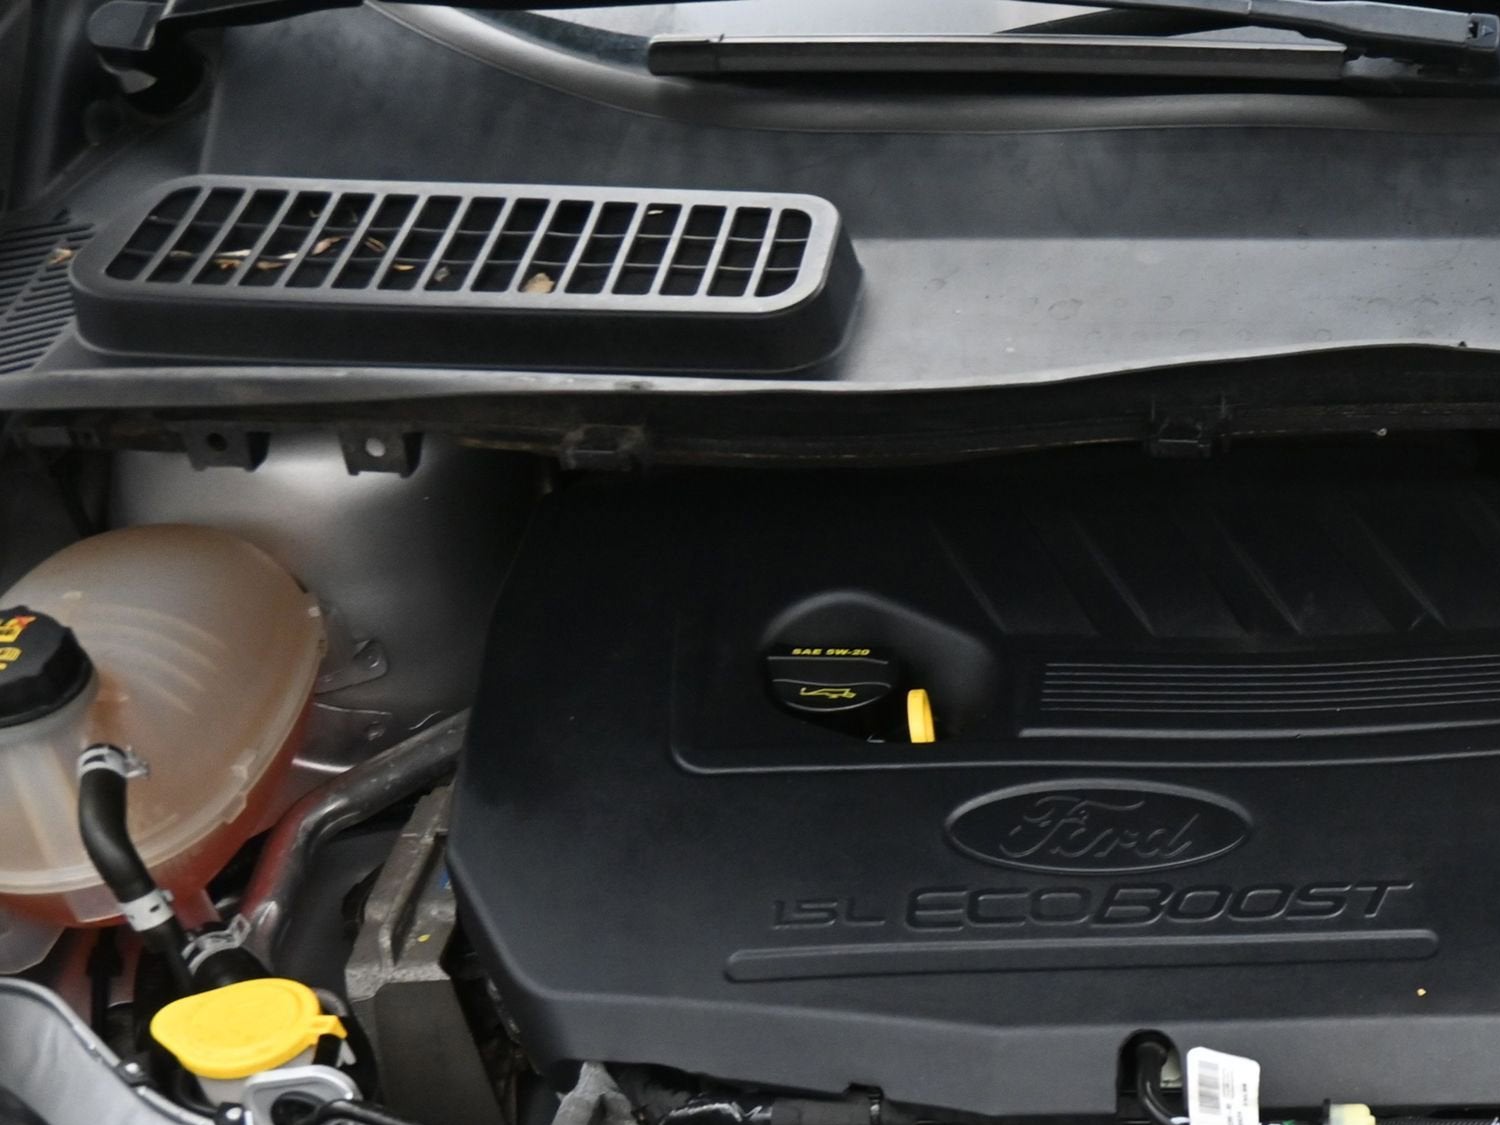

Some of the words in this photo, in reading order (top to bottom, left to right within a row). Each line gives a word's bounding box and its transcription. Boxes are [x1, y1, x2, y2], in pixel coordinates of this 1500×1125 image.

[791, 647, 822, 656] SAE
[825, 648, 871, 657] 5W-20
[998, 795, 1202, 860] Ford
